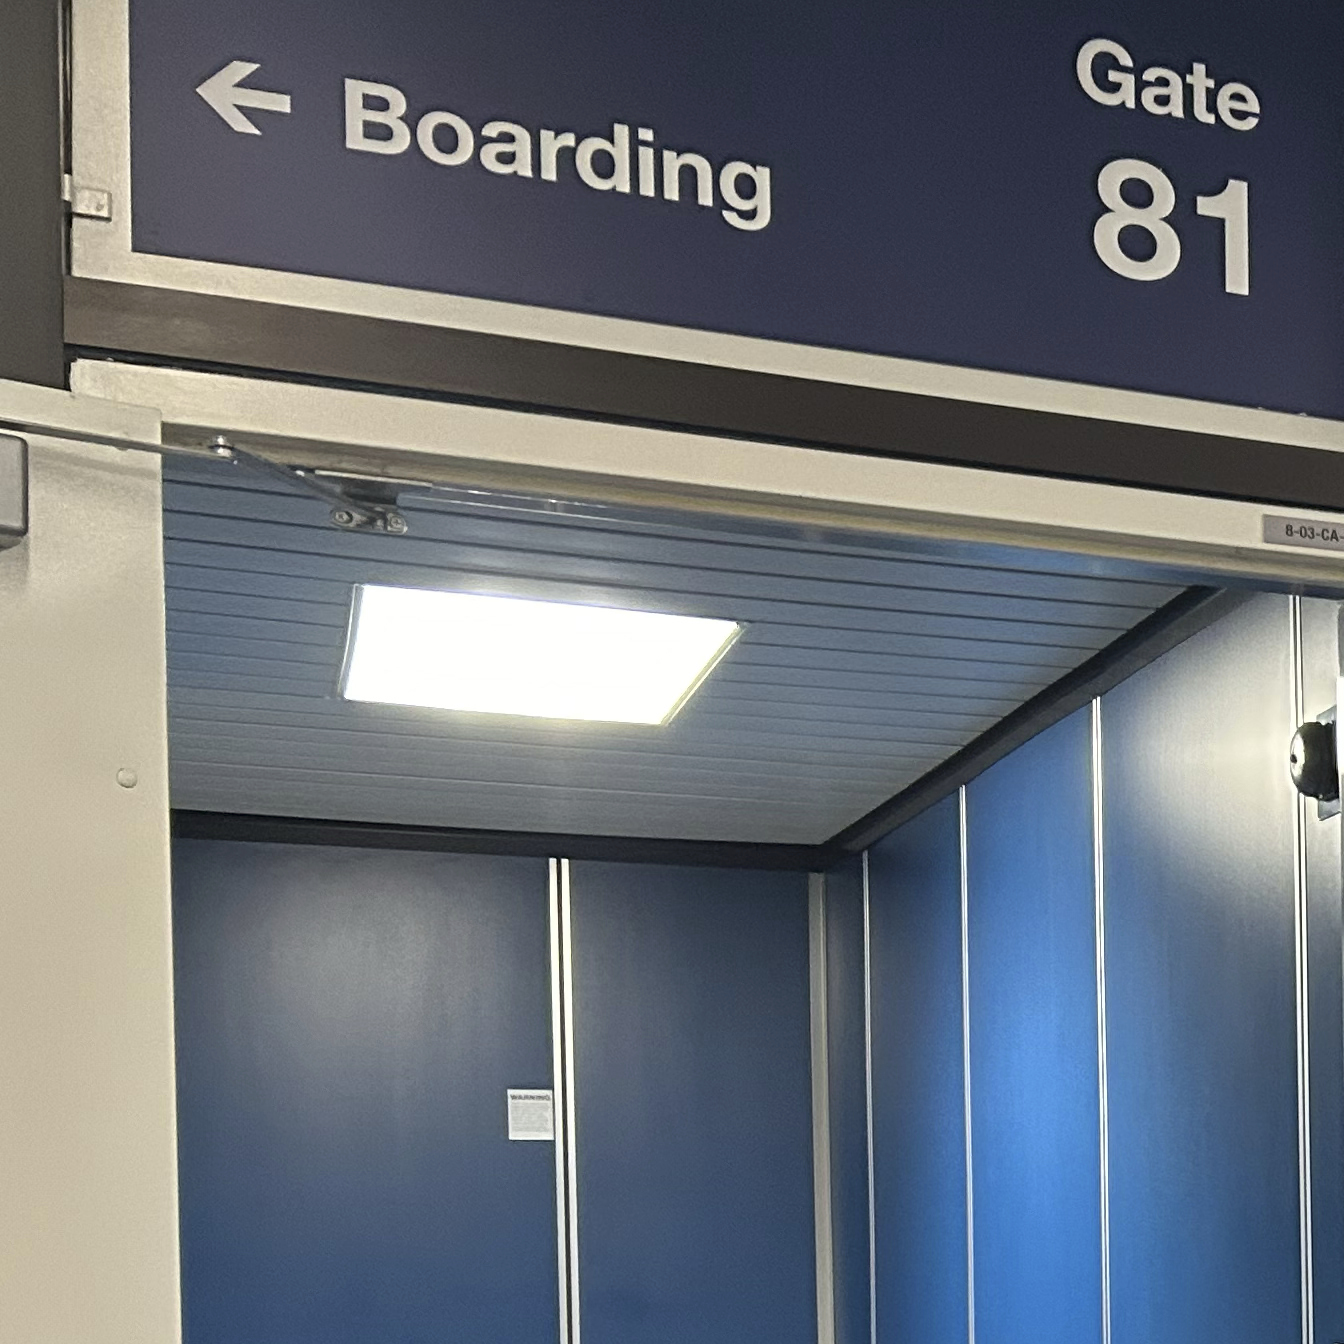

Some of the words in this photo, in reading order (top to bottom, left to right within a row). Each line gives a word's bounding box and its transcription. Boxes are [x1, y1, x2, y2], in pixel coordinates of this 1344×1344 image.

[1076, 38, 1261, 131] Gate
[344, 77, 771, 232] Boarding
[1093, 158, 1249, 296] 81
